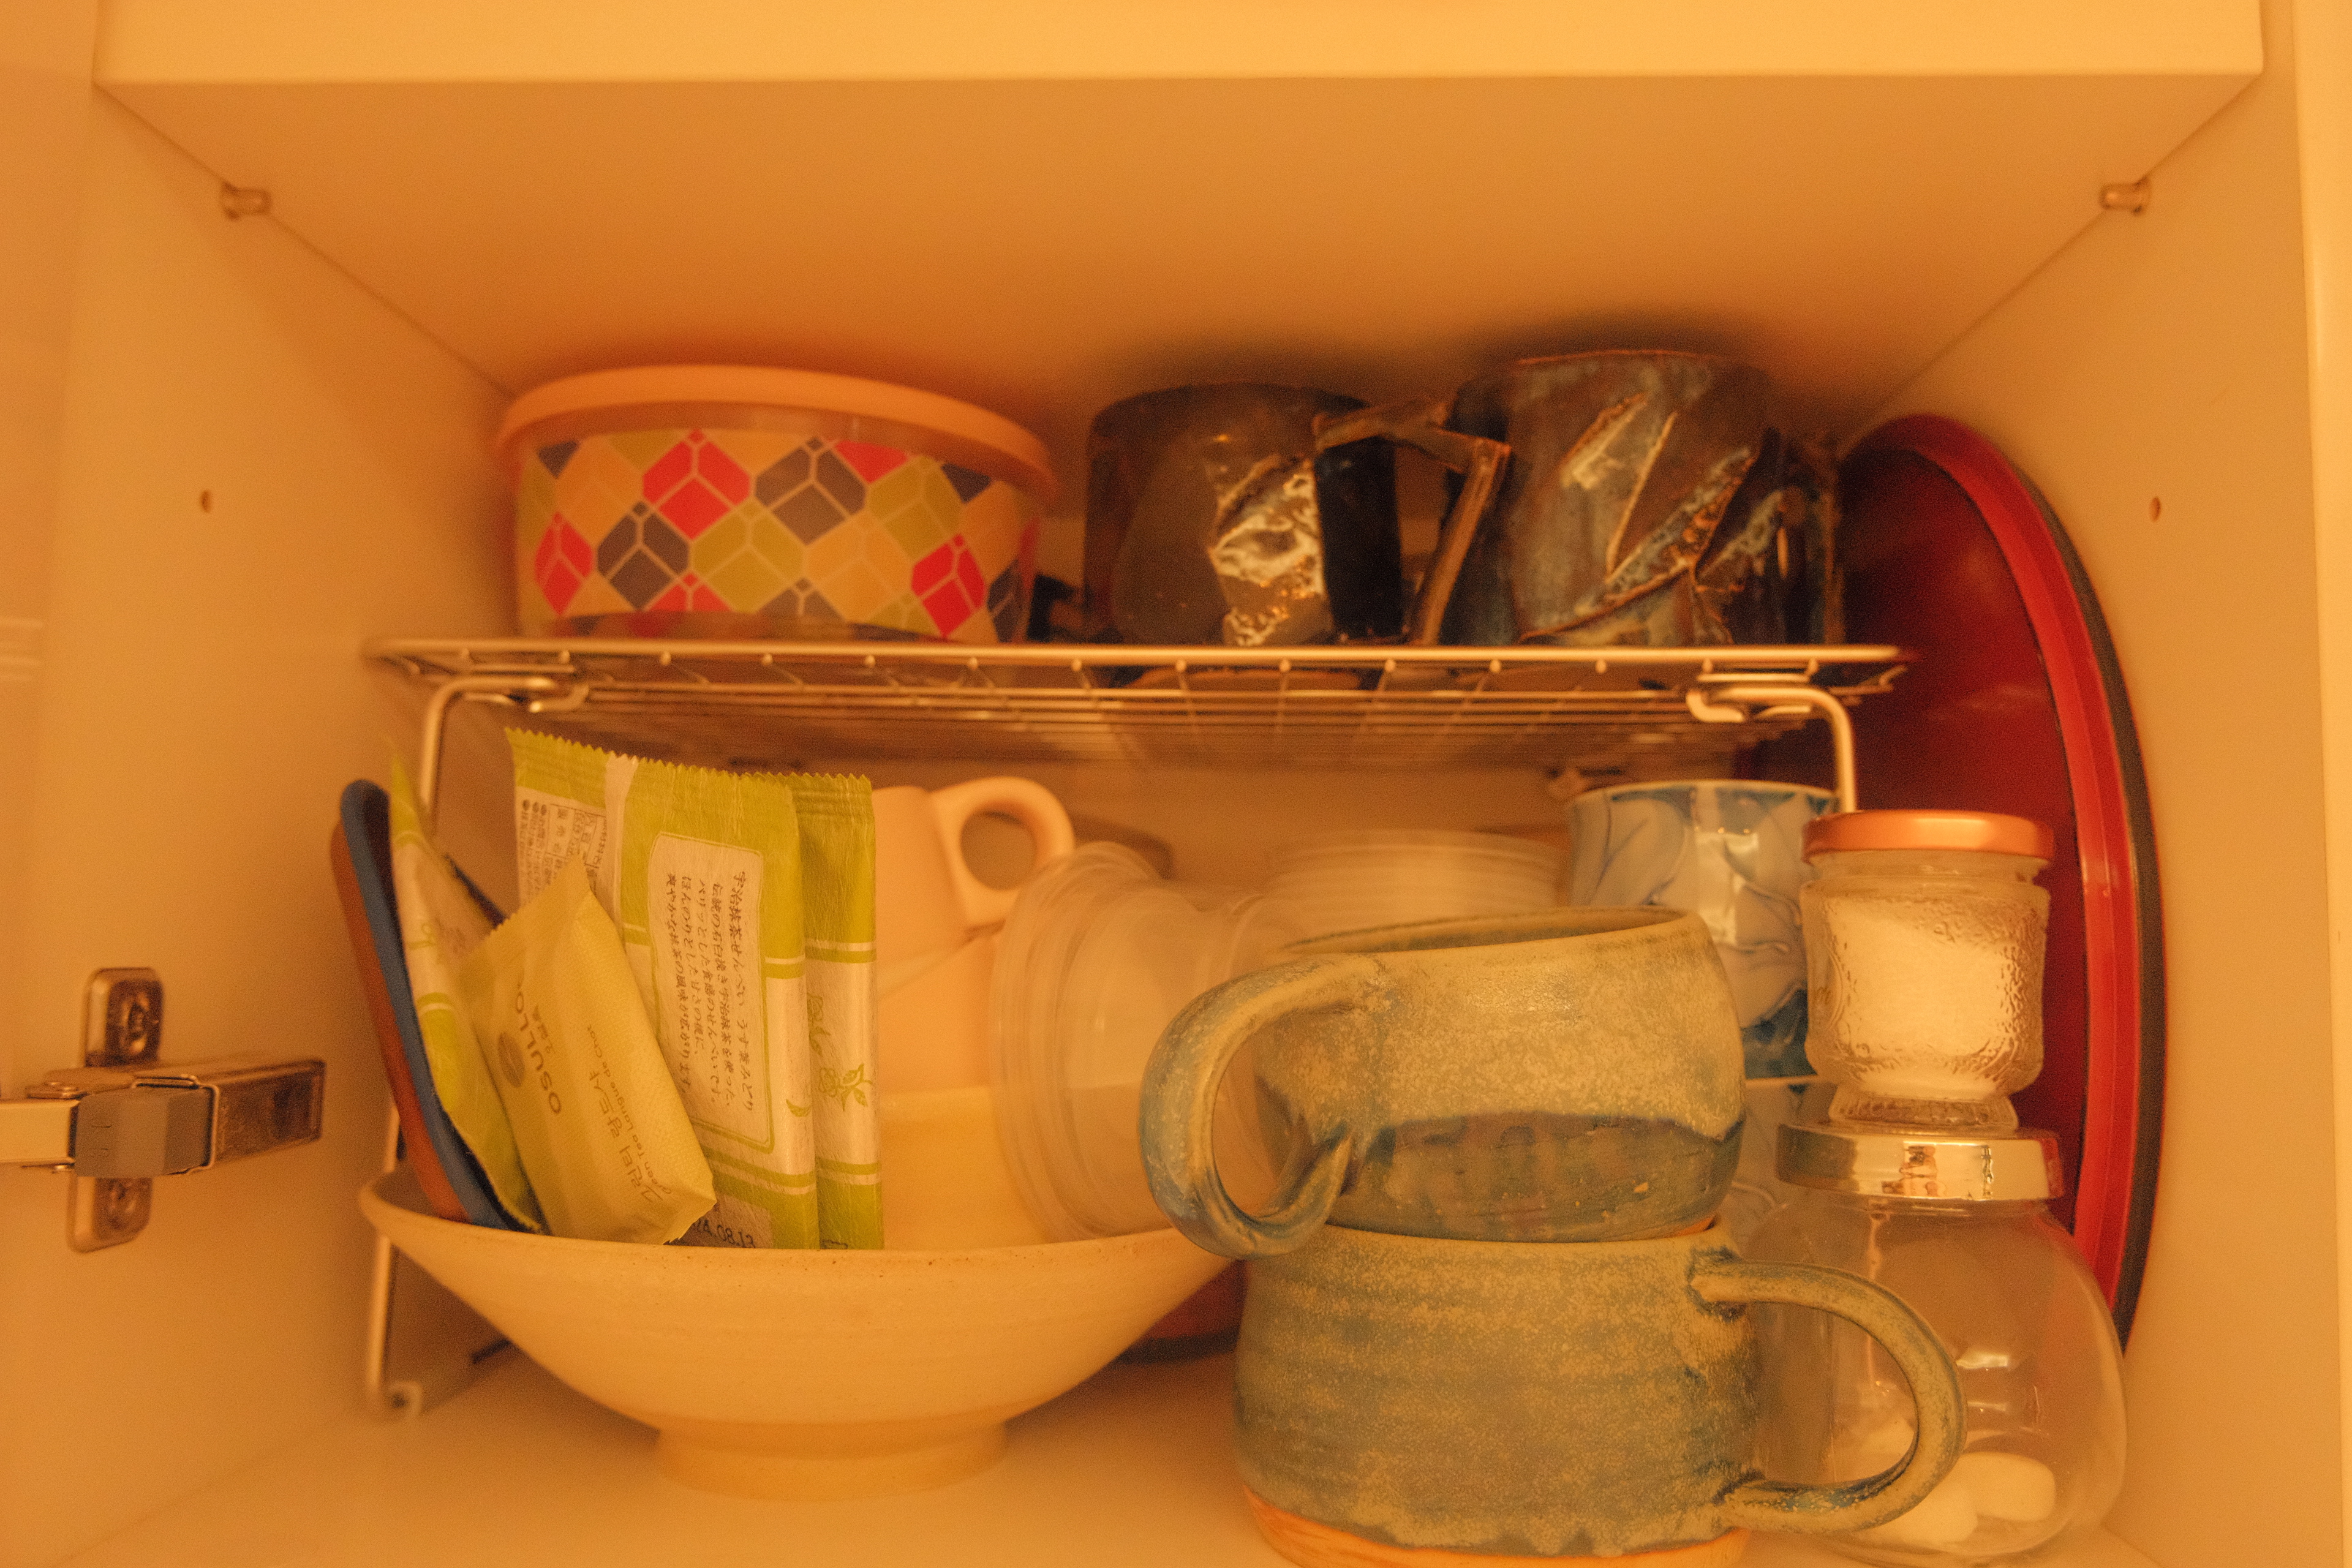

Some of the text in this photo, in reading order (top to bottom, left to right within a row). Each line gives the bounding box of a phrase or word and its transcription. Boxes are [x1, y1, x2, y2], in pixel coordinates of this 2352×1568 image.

[514, 973, 562, 1114] OSULLO
[586, 1023, 672, 1195] Green Tea Langue de Chat
[589, 1069, 663, 1202] 그린티 랑드샤
